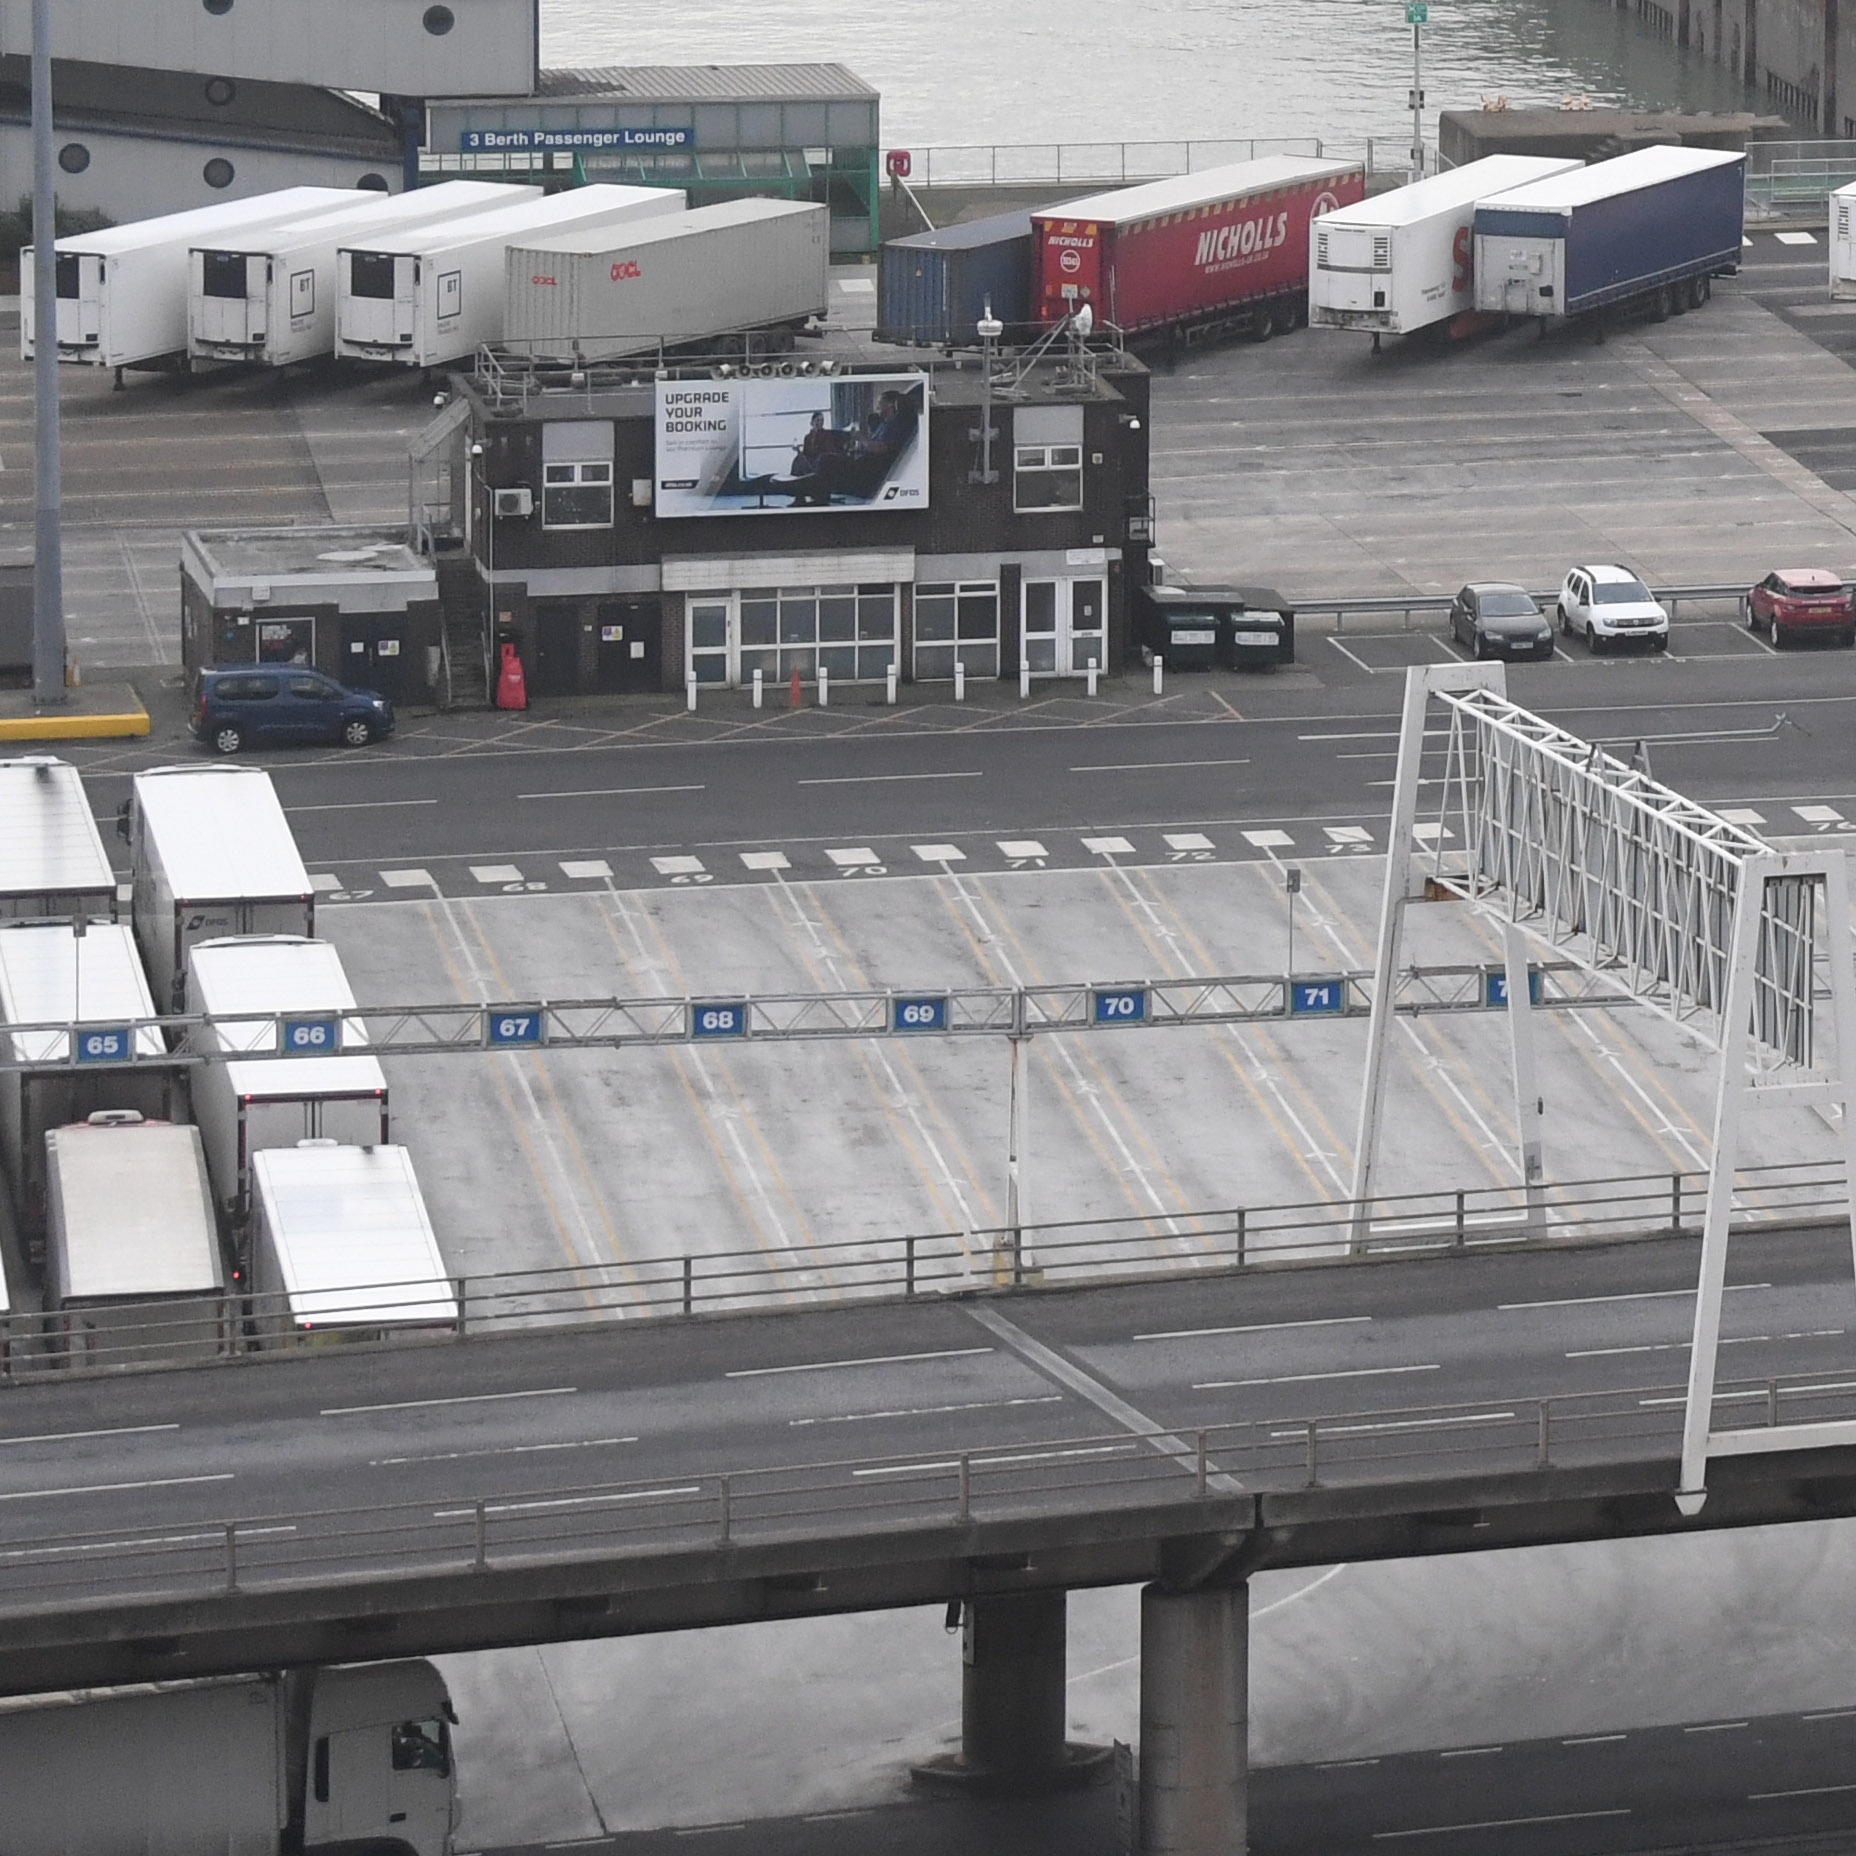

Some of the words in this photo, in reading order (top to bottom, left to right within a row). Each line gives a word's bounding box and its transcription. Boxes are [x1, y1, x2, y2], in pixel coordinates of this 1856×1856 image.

[469, 134, 480, 146] 3
[485, 132, 529, 146] Berth
[534, 131, 620, 147] Passenger
[625, 130, 686, 146] Lounge
[1048, 236, 1094, 248] NICHOLLS
[1194, 212, 1288, 266] NICHOLLS
[665, 392, 729, 405] UPGRADE
[665, 407, 703, 419] YOUR
[665, 419, 727, 433] BOOKING
[838, 866, 887, 877] 70
[1305, 988, 1329, 1005] 71
[904, 1005, 934, 1022] 69
[1105, 997, 1134, 1015] 70
[500, 1018, 530, 1036] 67
[703, 1011, 734, 1029] 68
[294, 1026, 325, 1044] 66
[87, 1036, 118, 1054] 65
